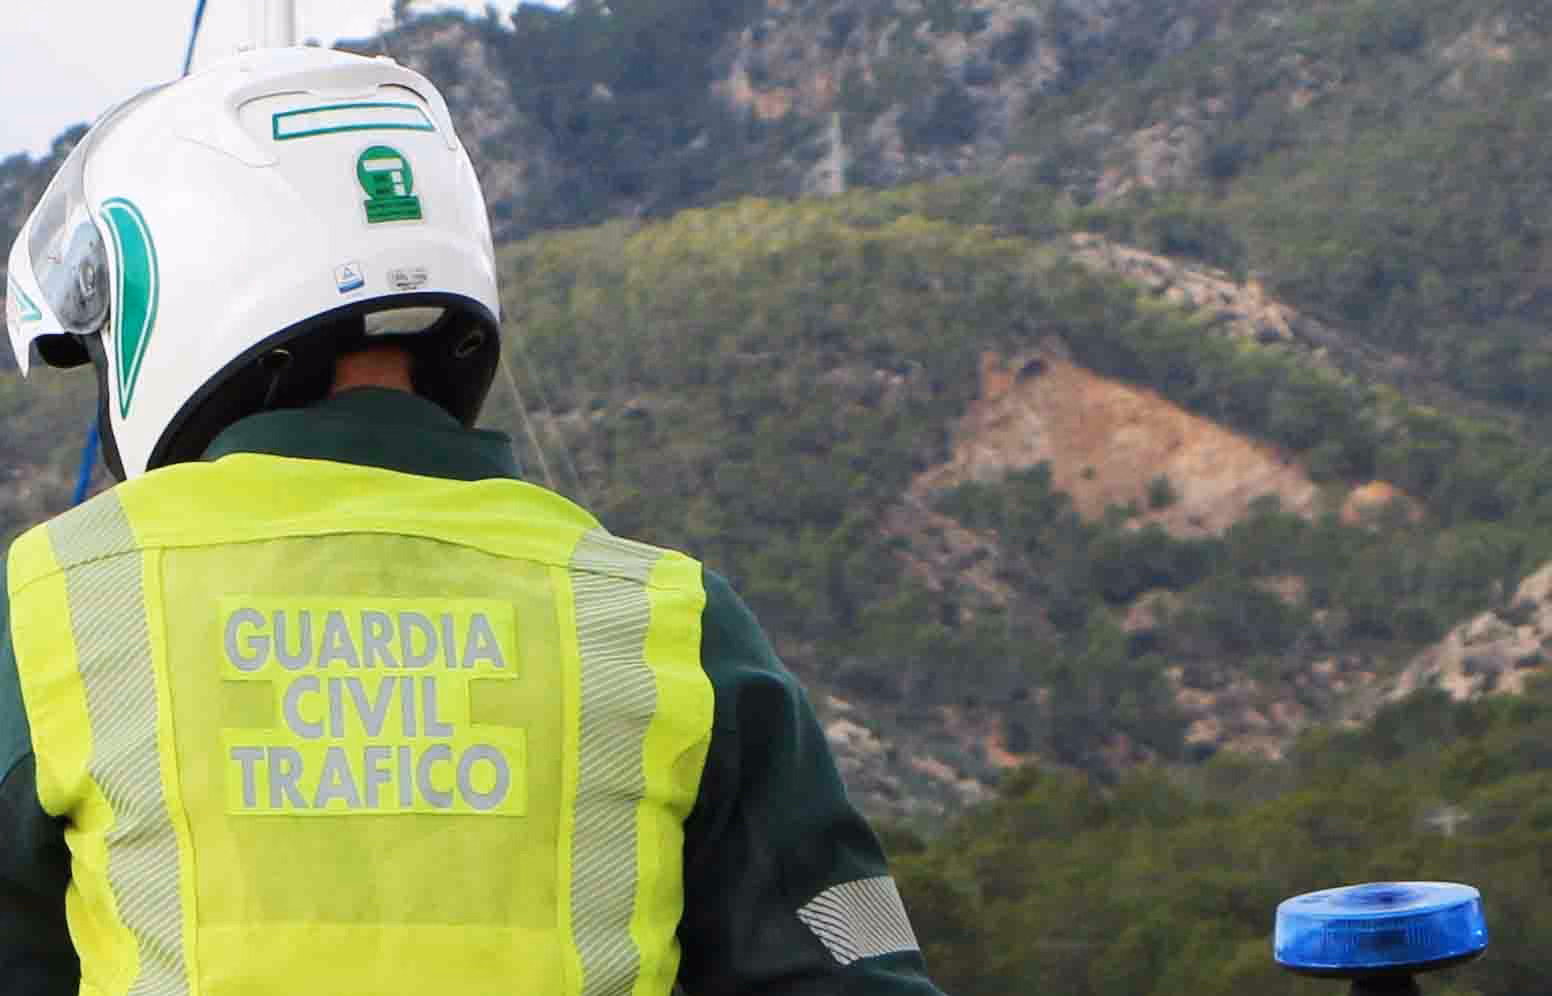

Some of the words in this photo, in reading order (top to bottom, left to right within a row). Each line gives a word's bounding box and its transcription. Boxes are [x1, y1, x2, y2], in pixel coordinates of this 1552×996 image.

[224, 608, 505, 671] GUARDIA
[282, 675, 455, 739] CIVIL
[229, 743, 510, 810] TRAFICO
